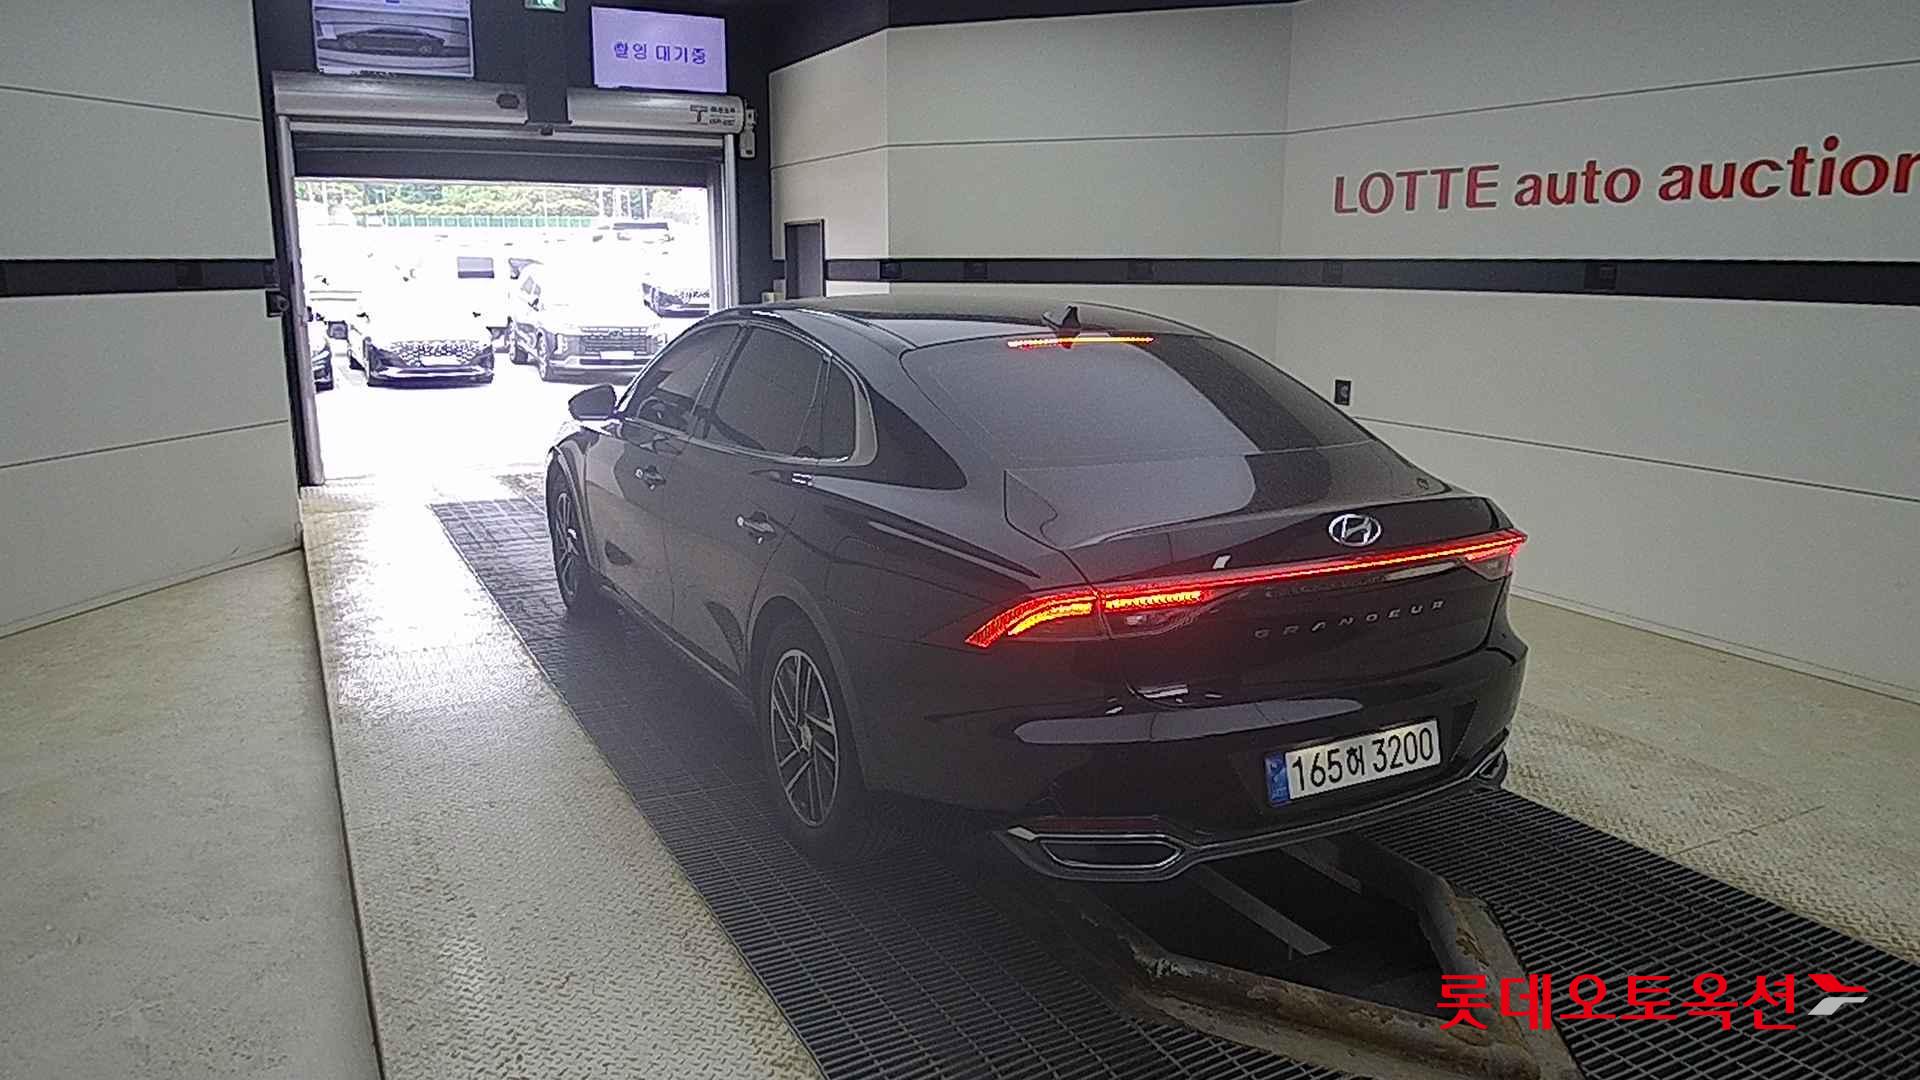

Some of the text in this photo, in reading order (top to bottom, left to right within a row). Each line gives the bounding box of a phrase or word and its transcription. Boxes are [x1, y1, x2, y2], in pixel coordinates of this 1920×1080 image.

[1334, 163, 1500, 214] LOTTE
[1514, 159, 1641, 207] auto
[1291, 745, 1366, 792] 165허
[1372, 727, 1435, 774] 3200
